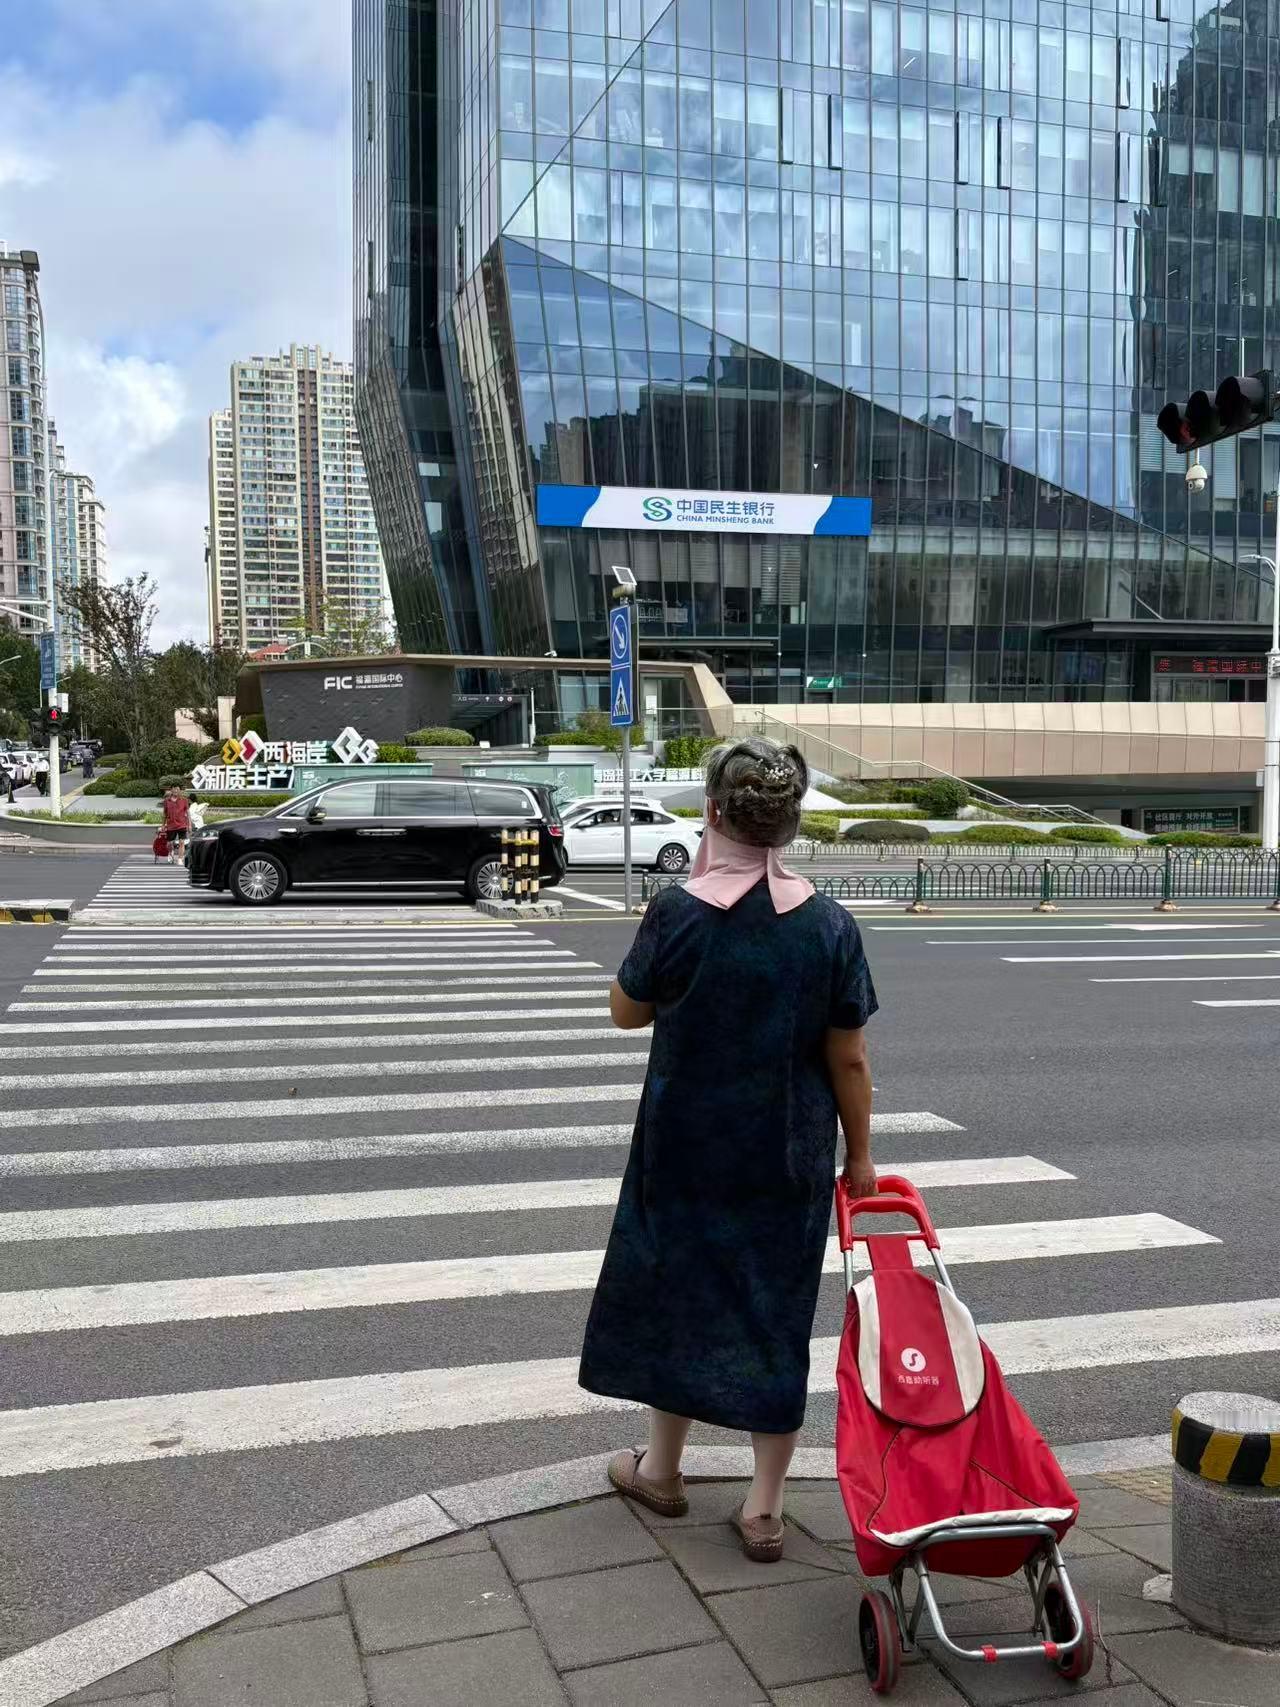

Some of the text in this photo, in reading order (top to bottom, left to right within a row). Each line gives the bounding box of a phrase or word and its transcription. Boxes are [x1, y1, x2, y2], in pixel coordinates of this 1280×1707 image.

[676, 499, 775, 516] 中国民生银行
[676, 514, 775, 525] CHINA MINSHENG BANK
[324, 676, 353, 690] FIC
[263, 741, 327, 763] 西海岸
[205, 764, 295, 790] 新质生产
